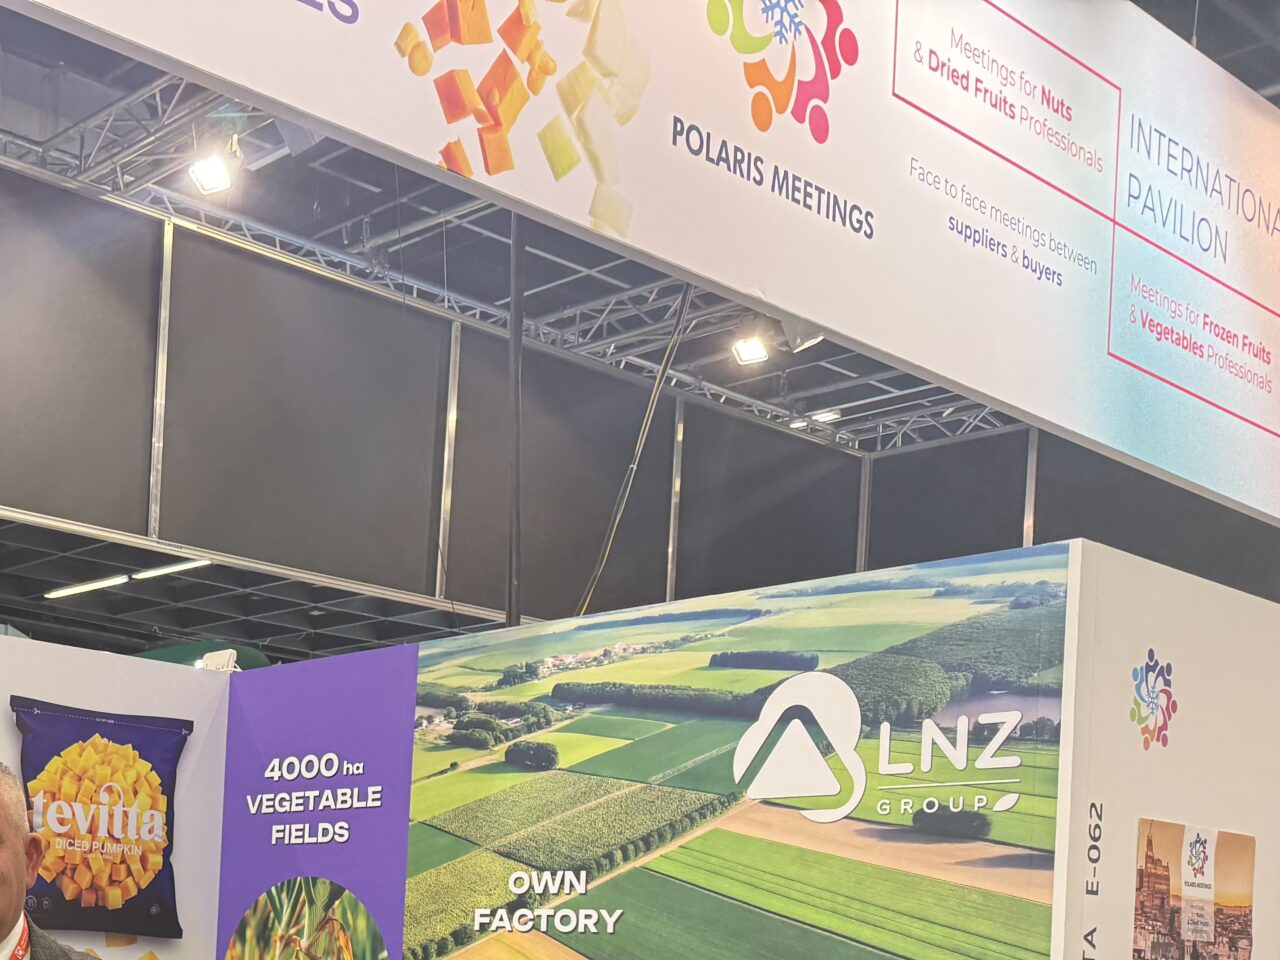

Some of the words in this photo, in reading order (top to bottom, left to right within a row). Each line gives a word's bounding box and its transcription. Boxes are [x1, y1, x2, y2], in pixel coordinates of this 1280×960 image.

[914, 41, 924, 65] &
[928, 49, 969, 92] Dried
[974, 78, 1016, 119] Fruits
[1020, 105, 1103, 173] Professionals
[950, 27, 1016, 87] Meetings
[1020, 71, 1037, 99] for
[1041, 85, 1072, 121] Nuts
[672, 115, 764, 187] POLARIS
[771, 165, 874, 240] MEETINGS
[1130, 113, 1280, 237] INTERNATIONA
[910, 158, 941, 190] Face
[945, 177, 957, 199] to
[961, 185, 987, 215] face
[990, 206, 1046, 247] meetings
[1049, 232, 1097, 275] between
[948, 216, 1008, 258] suppliers
[1010, 244, 1019, 264] &
[1022, 250, 1063, 287] buyers
[1128, 173, 1227, 264] PAVILION
[1129, 304, 1137, 324] &
[1140, 308, 1205, 359] Vegetables
[1207, 344, 1273, 394] Professionals
[1130, 272, 1183, 319] Meetings
[1186, 302, 1200, 326] for
[1203, 313, 1239, 348] Frozen
[1242, 334, 1272, 365] Fruits
[264, 752, 339, 781] 4000
[343, 760, 364, 776] ha
[878, 710, 1023, 775] LNZ
[32, 782, 163, 842] tevitta
[246, 786, 382, 814] VEGETABLE
[271, 821, 350, 845] FIELDS
[877, 795, 988, 815] GROUP
[55, 838, 90, 852] DICED
[92, 840, 142, 856] PUMPKIN
[1086, 802, 1103, 896] E-062
[508, 870, 588, 896] OWN
[473, 908, 624, 934] FACTORY
